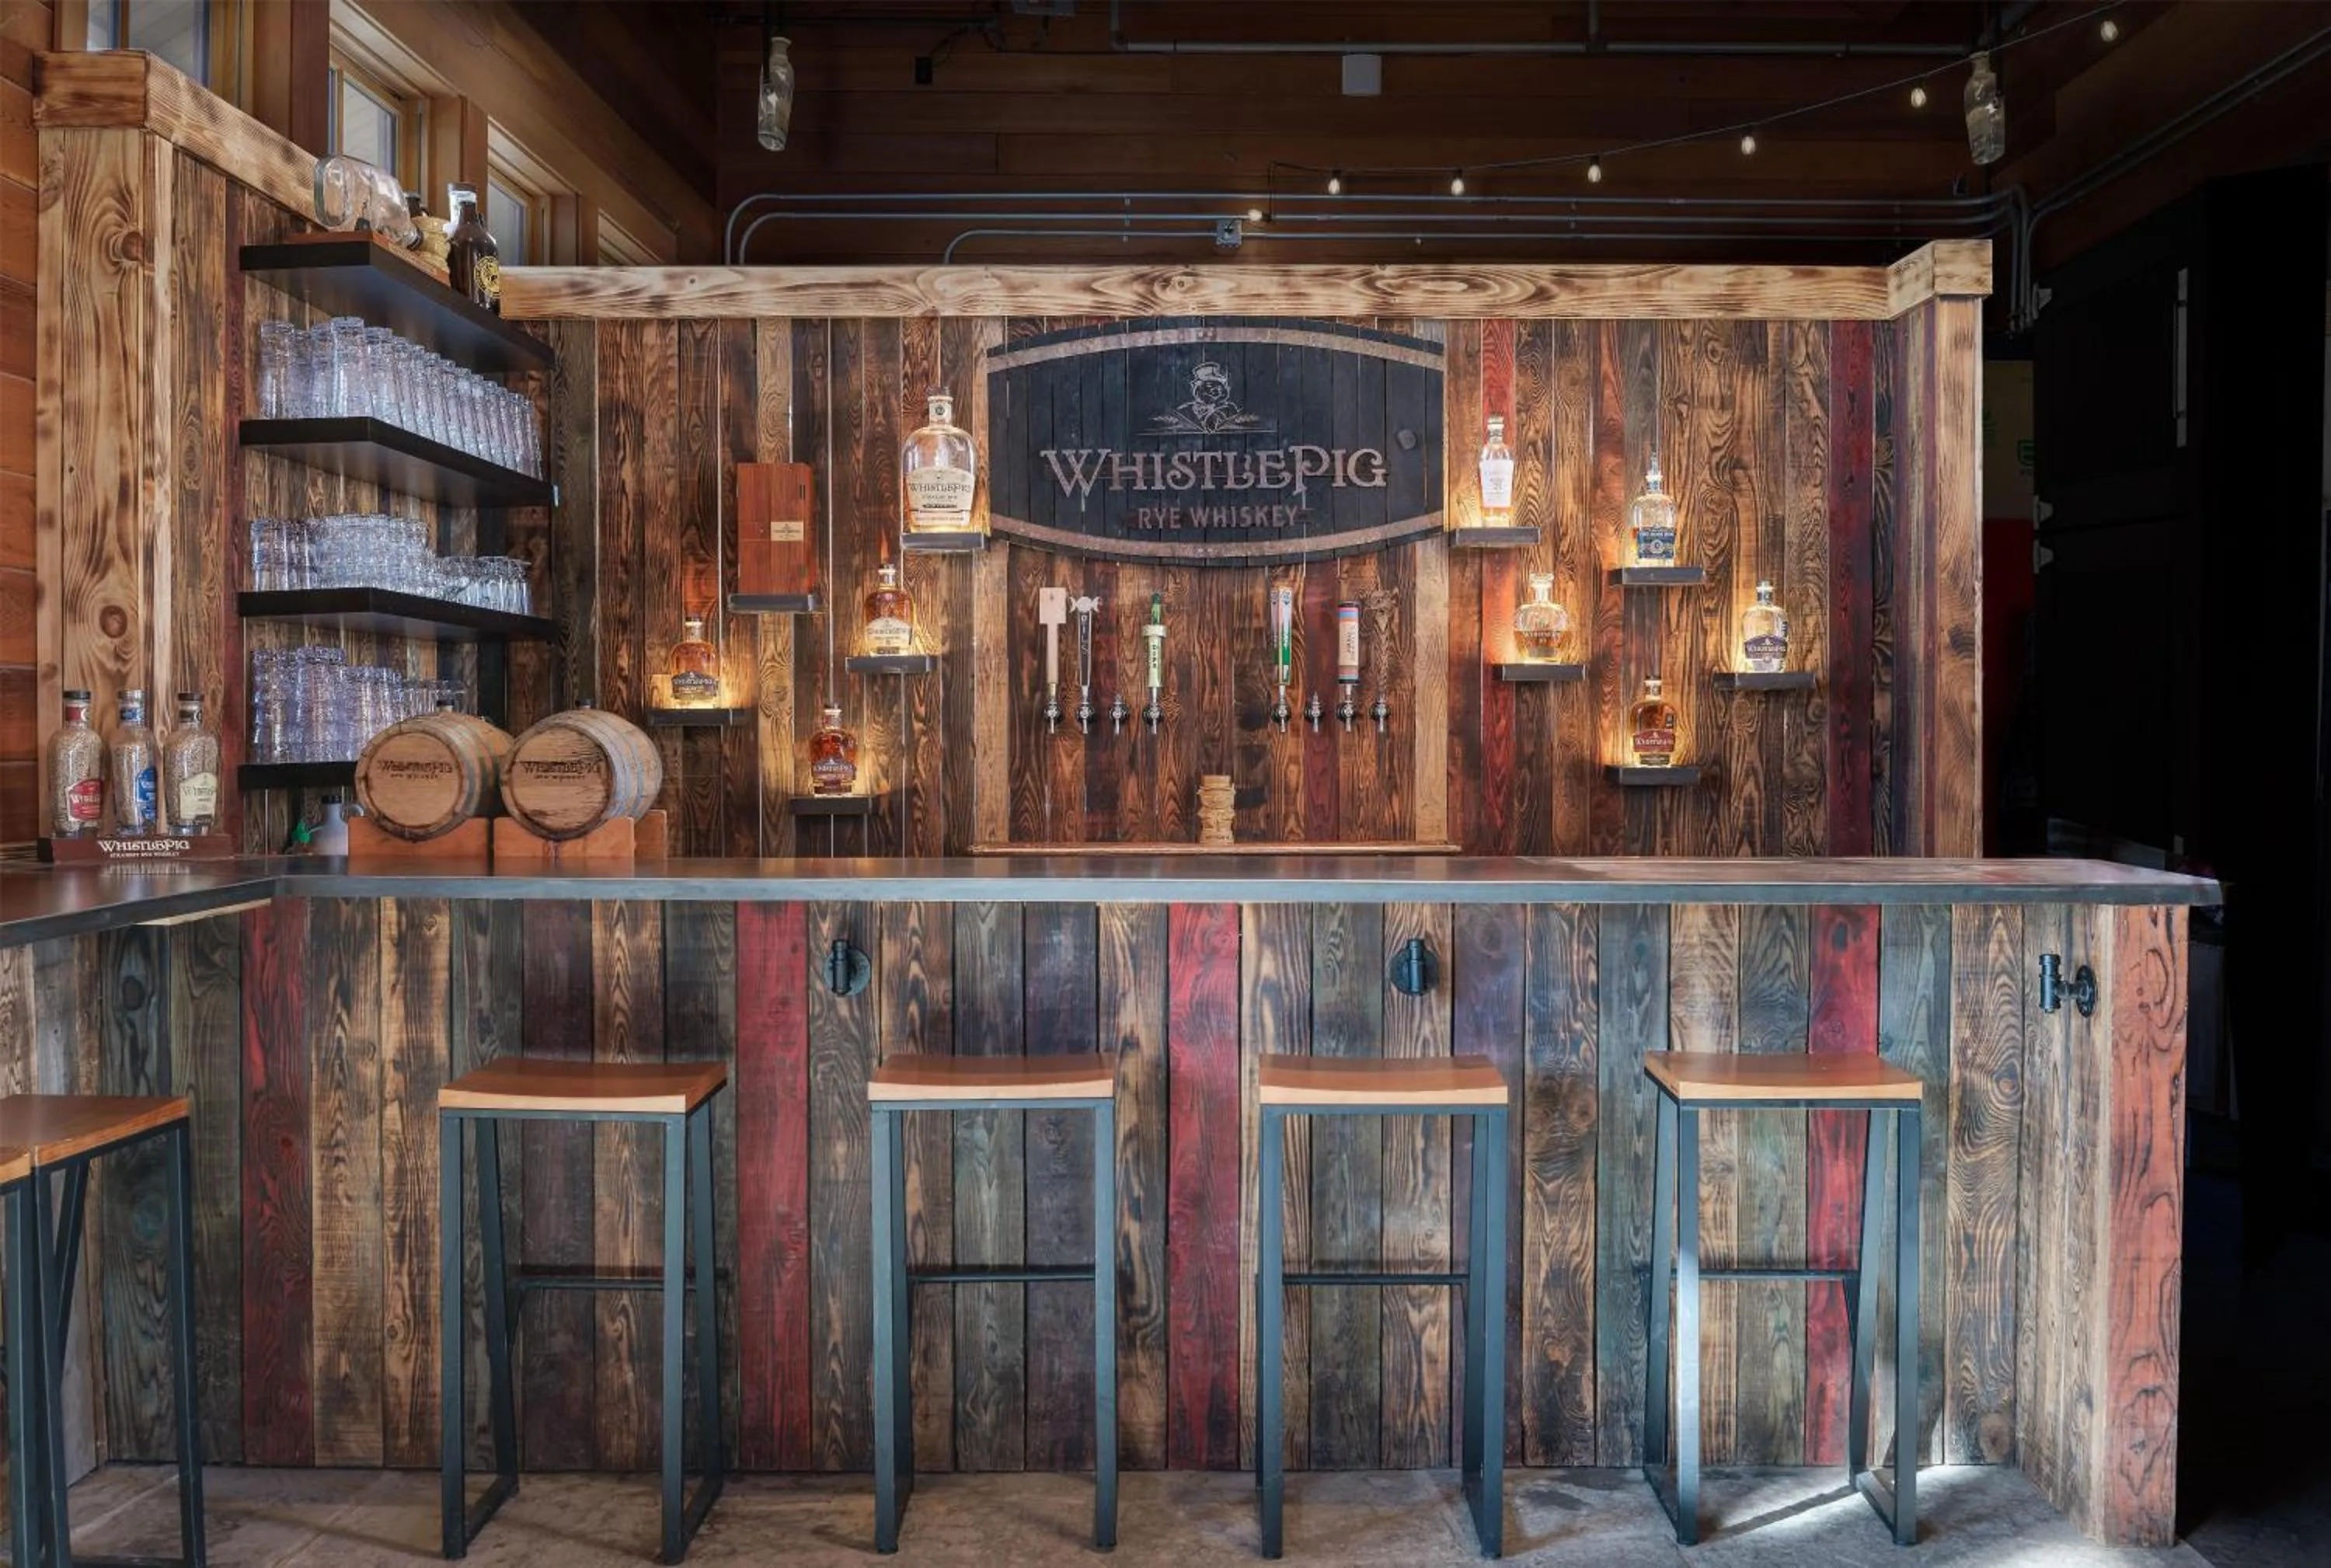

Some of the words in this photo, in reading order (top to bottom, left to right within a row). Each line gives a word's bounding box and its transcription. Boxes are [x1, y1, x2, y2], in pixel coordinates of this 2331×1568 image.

[1040, 444, 1388, 497] WHISTLEPIG
[1138, 507, 1181, 530] RYE
[1192, 504, 1299, 529] WHISKEY
[97, 839, 190, 852] WHISTLEPIG
